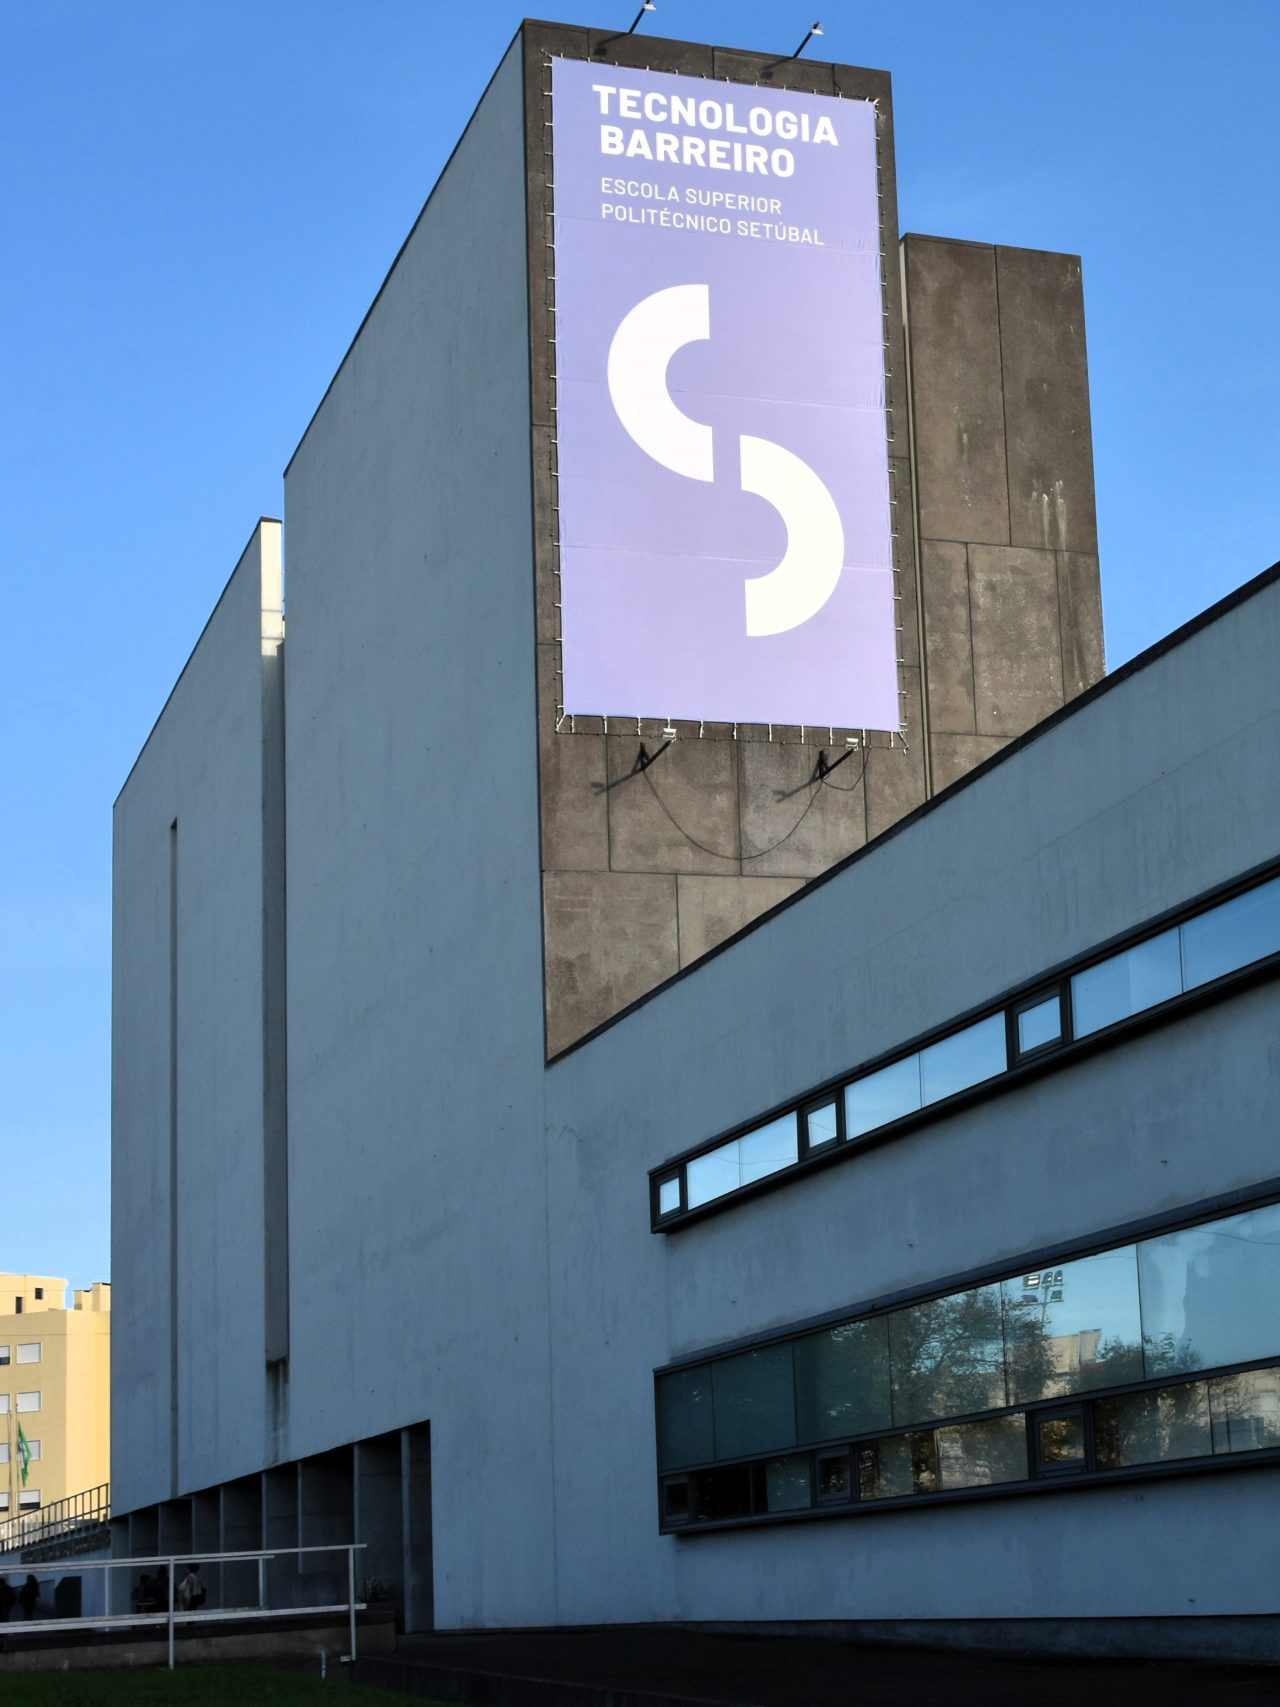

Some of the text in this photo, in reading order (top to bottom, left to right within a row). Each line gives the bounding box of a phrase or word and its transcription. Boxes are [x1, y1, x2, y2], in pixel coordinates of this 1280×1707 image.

[593, 85, 839, 145] TECNOLOGIA
[600, 125, 794, 177] BARREIRO
[601, 178, 782, 215] ESCOLA SUPERIOR
[601, 203, 824, 246] POLITÉCNICO SETÚBAL
